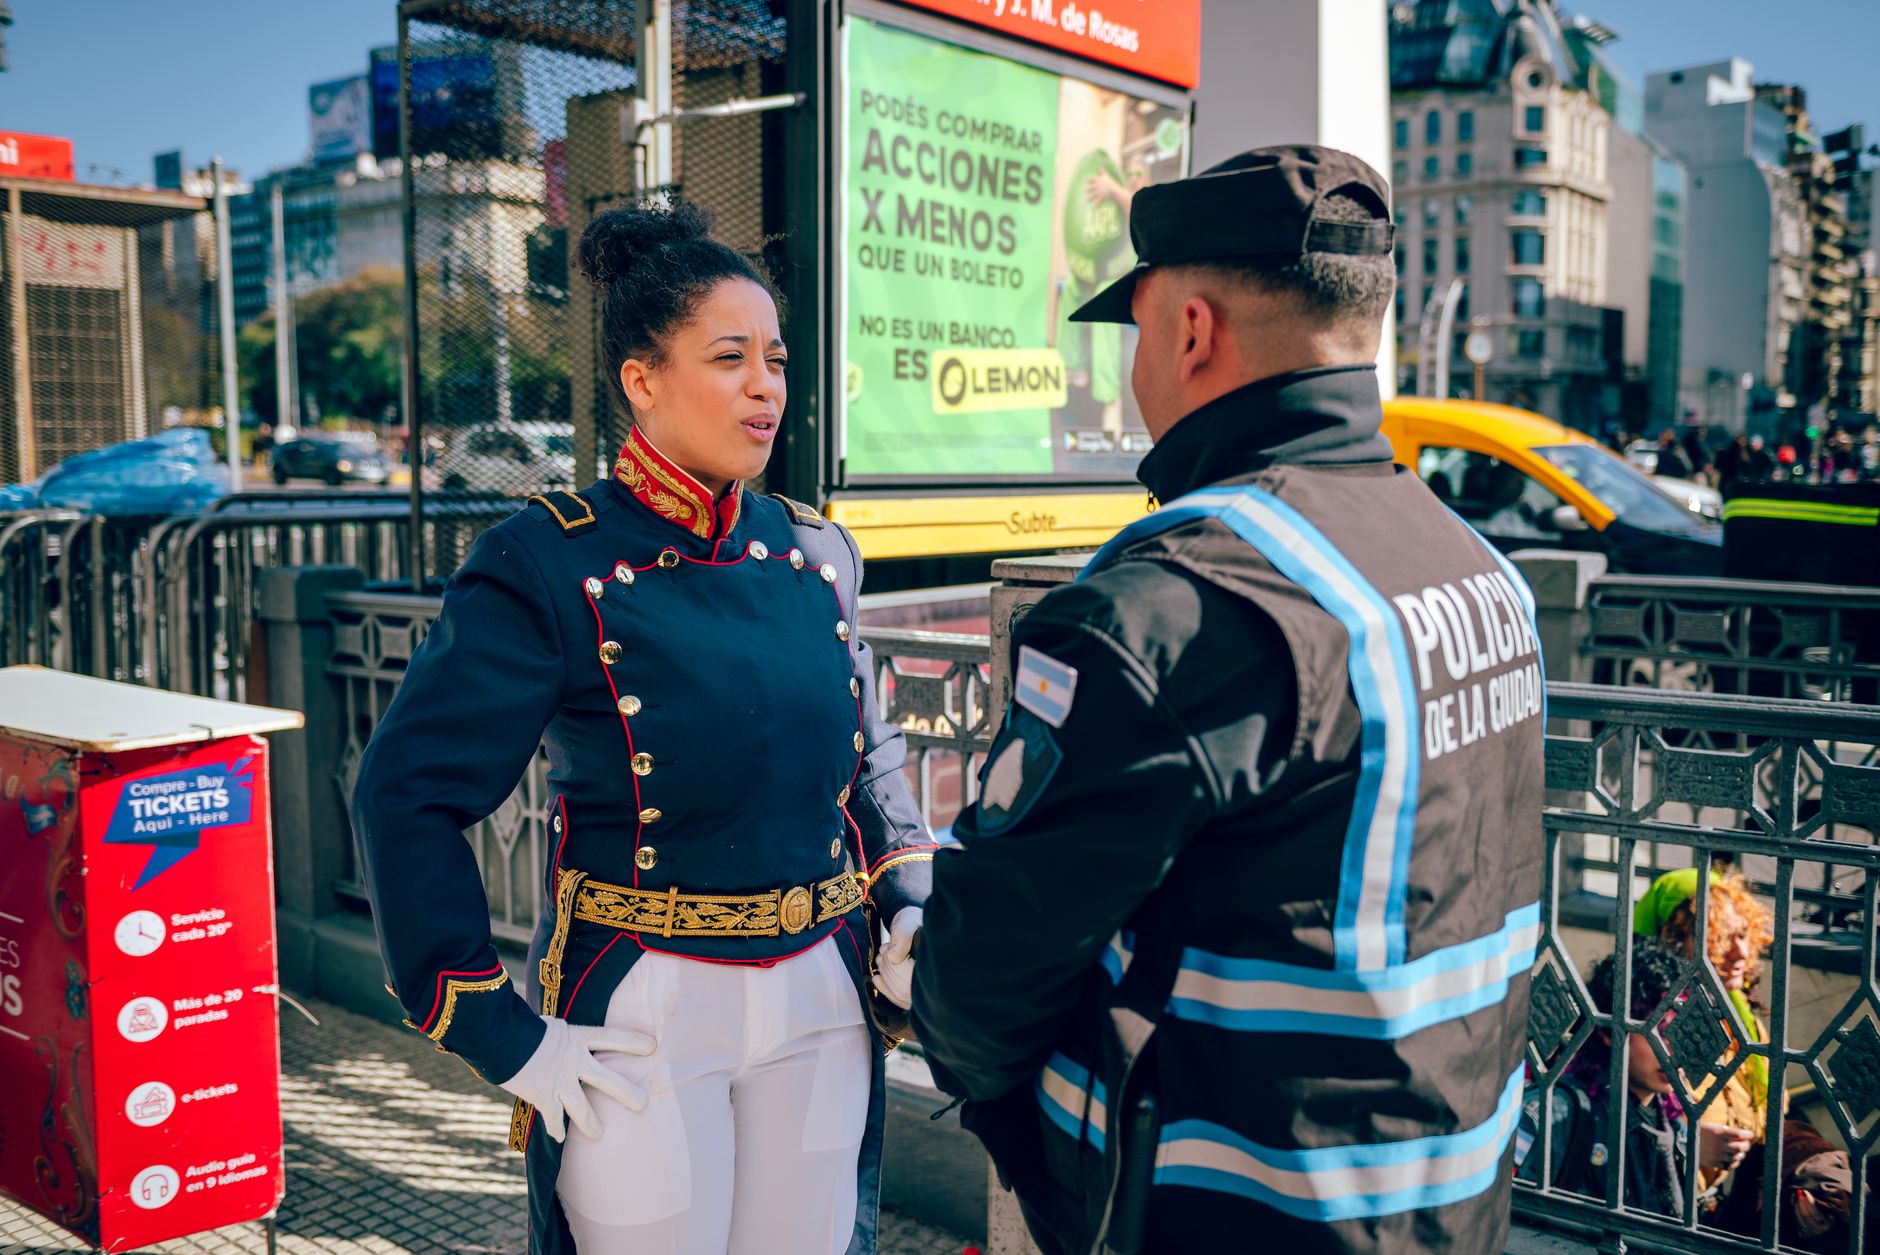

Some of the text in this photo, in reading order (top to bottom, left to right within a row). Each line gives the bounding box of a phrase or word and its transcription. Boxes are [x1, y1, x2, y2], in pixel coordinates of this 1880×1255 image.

[1031, 0, 1057, 26] M.
[1061, 1, 1086, 35] de
[1089, 10, 1139, 52] Rosas
[860, 88, 1043, 155] PODÉS COMPRAR
[861, 128, 1043, 204] ACCIONES
[860, 187, 1017, 255] X MENOS
[859, 244, 1024, 289] QUE UN BOLETO
[860, 314, 1020, 349] NO ES UN BANCO.
[894, 348, 1061, 395] ES LEMON
[1009, 511, 1057, 534] Subte
[1424, 694, 1458, 760] DE
[1458, 684, 1486, 746] LA
[130, 780, 187, 797] Compre
[196, 775, 225, 790] Buy
[128, 788, 230, 818] TICKETS
[189, 810, 230, 826] Here
[171, 907, 226, 926] Servicio
[172, 927, 206, 942] cada
[173, 988, 243, 1012] Más de 20
[174, 1009, 229, 1030] paradas
[181, 1083, 238, 1103] e-tickets
[185, 1160, 226, 1178] Audio
[186, 1165, 268, 1193] en 9 idiomas
